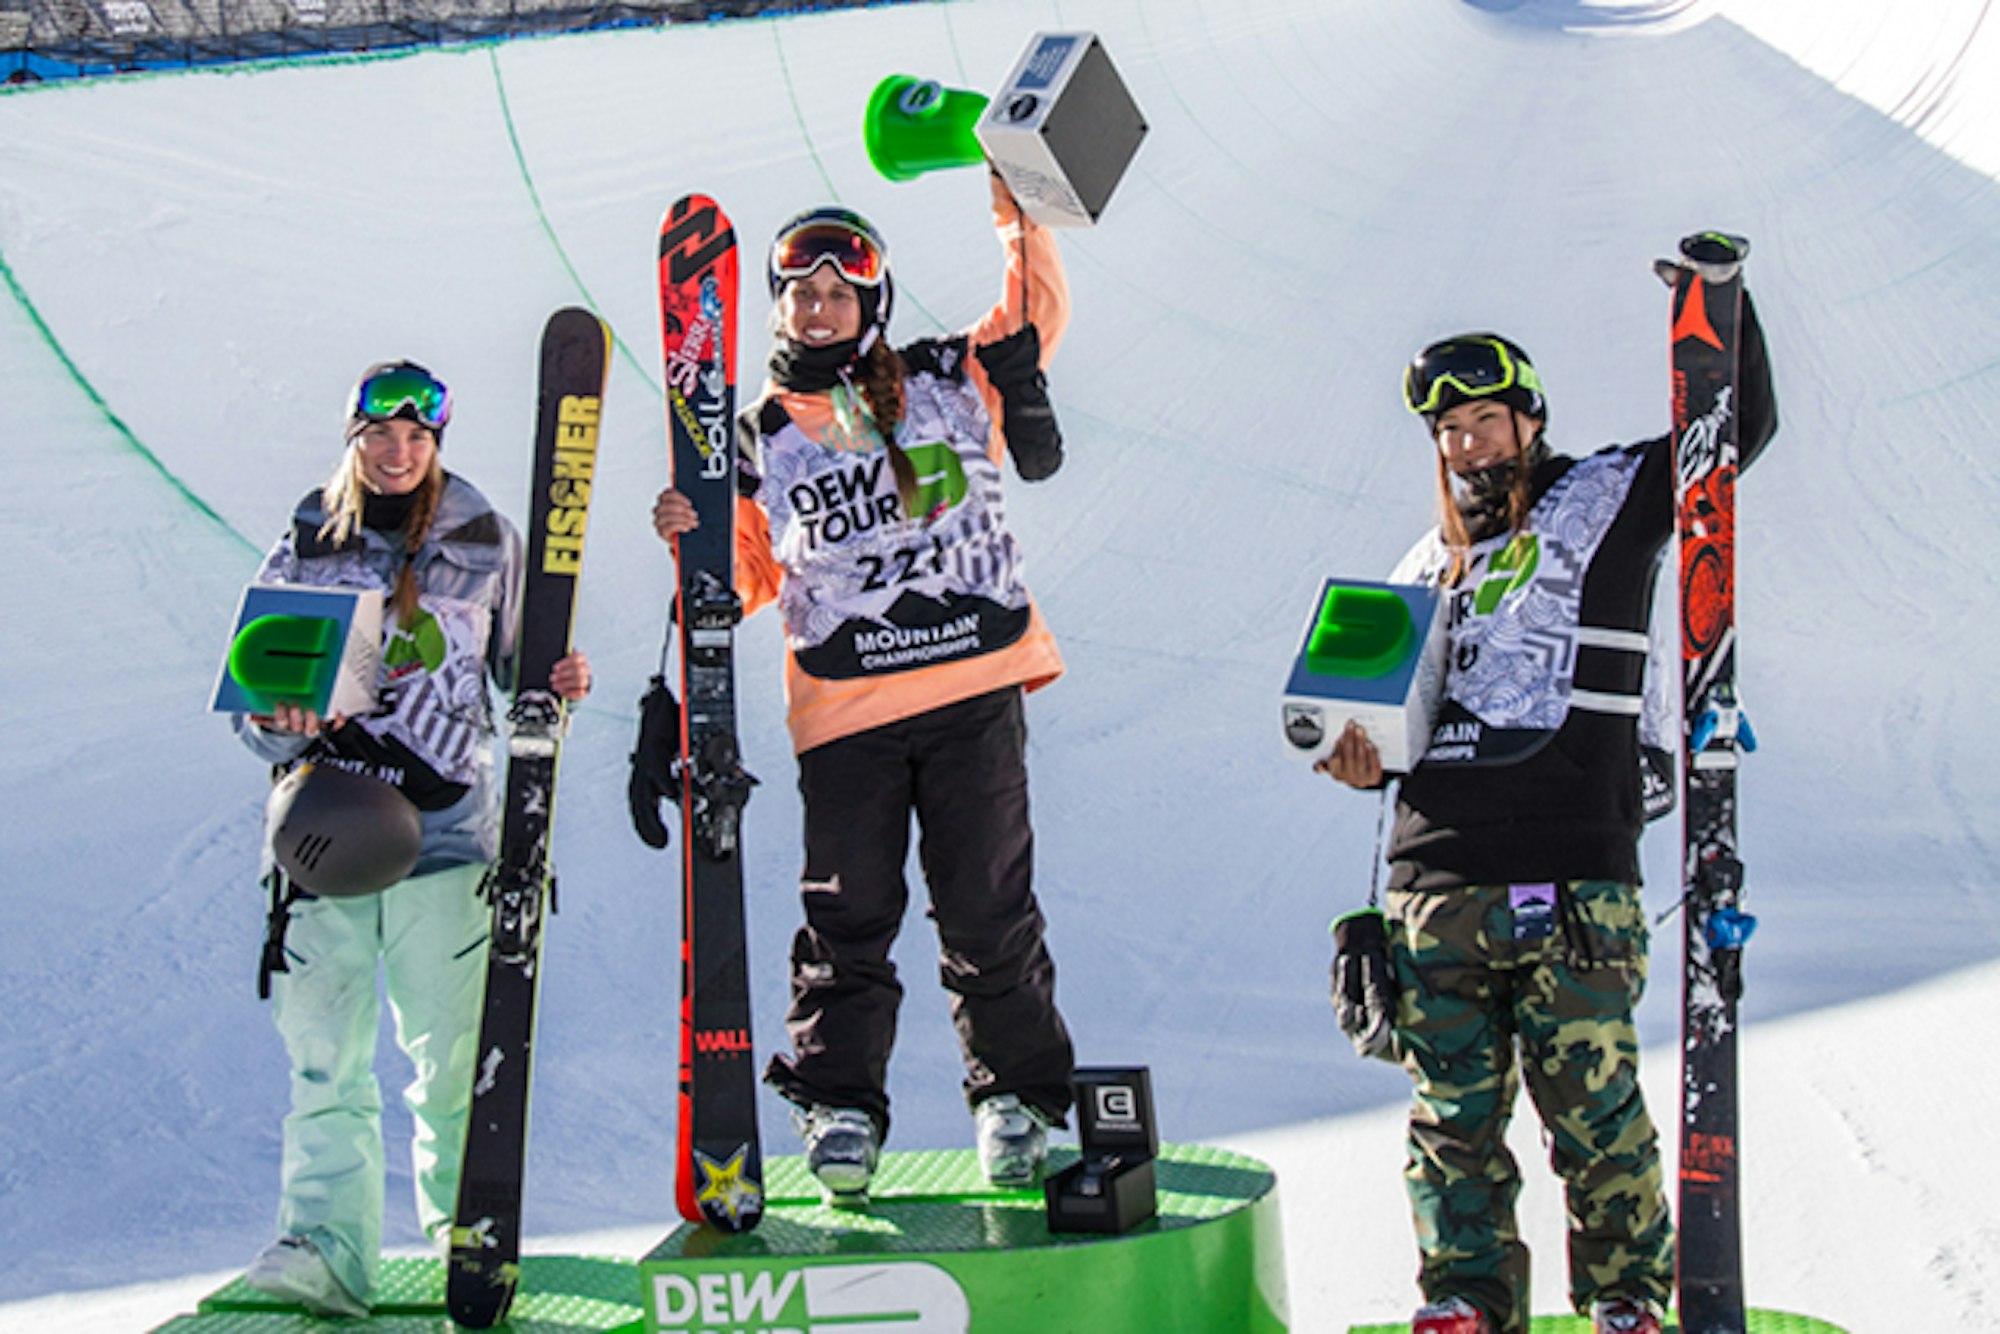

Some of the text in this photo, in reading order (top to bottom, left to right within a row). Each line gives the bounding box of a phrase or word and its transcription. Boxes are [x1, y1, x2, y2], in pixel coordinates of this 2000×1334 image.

[543, 394, 600, 574] FISCHER
[788, 457, 885, 516] DEW
[801, 493, 902, 550] TOUR
[653, 1270, 802, 1325] DEW
